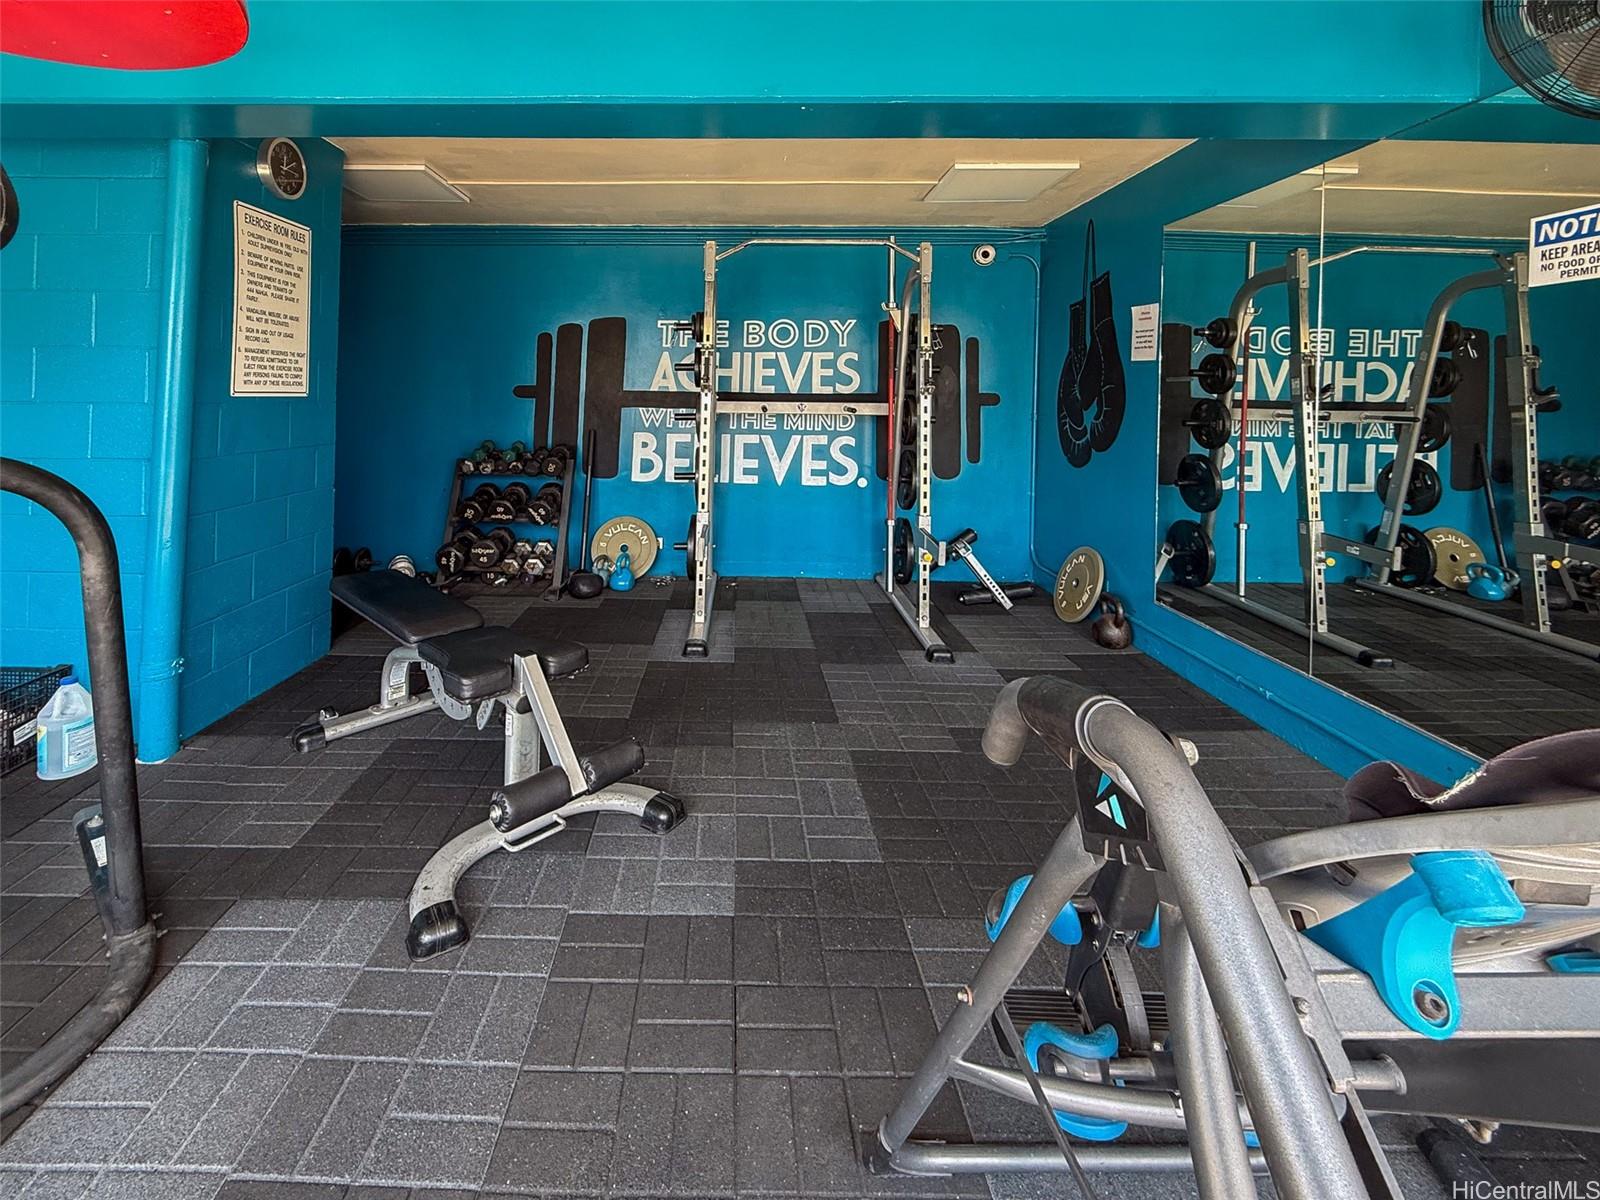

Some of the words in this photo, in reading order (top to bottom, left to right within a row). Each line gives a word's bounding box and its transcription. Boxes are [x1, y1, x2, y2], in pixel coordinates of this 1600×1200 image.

[245, 213, 272, 232] EXERCISE
[274, 223, 289, 237] ROOM
[290, 229, 306, 243] RULES
[1540, 246, 1568, 262] KEEP
[1571, 240, 1600, 257] AREA
[1540, 262, 1554, 272] NO
[1558, 257, 1585, 270] FOOD
[1560, 266, 1600, 278] PERMIT
[744, 319, 857, 348] BODY
[650, 352, 861, 394] ACHIEVES
[638, 407, 696, 428] WH
[730, 414, 776, 430] THE
[784, 414, 856, 431] MIND
[604, 524, 648, 545] VULCAN
[1058, 554, 1086, 600] VULCAN
